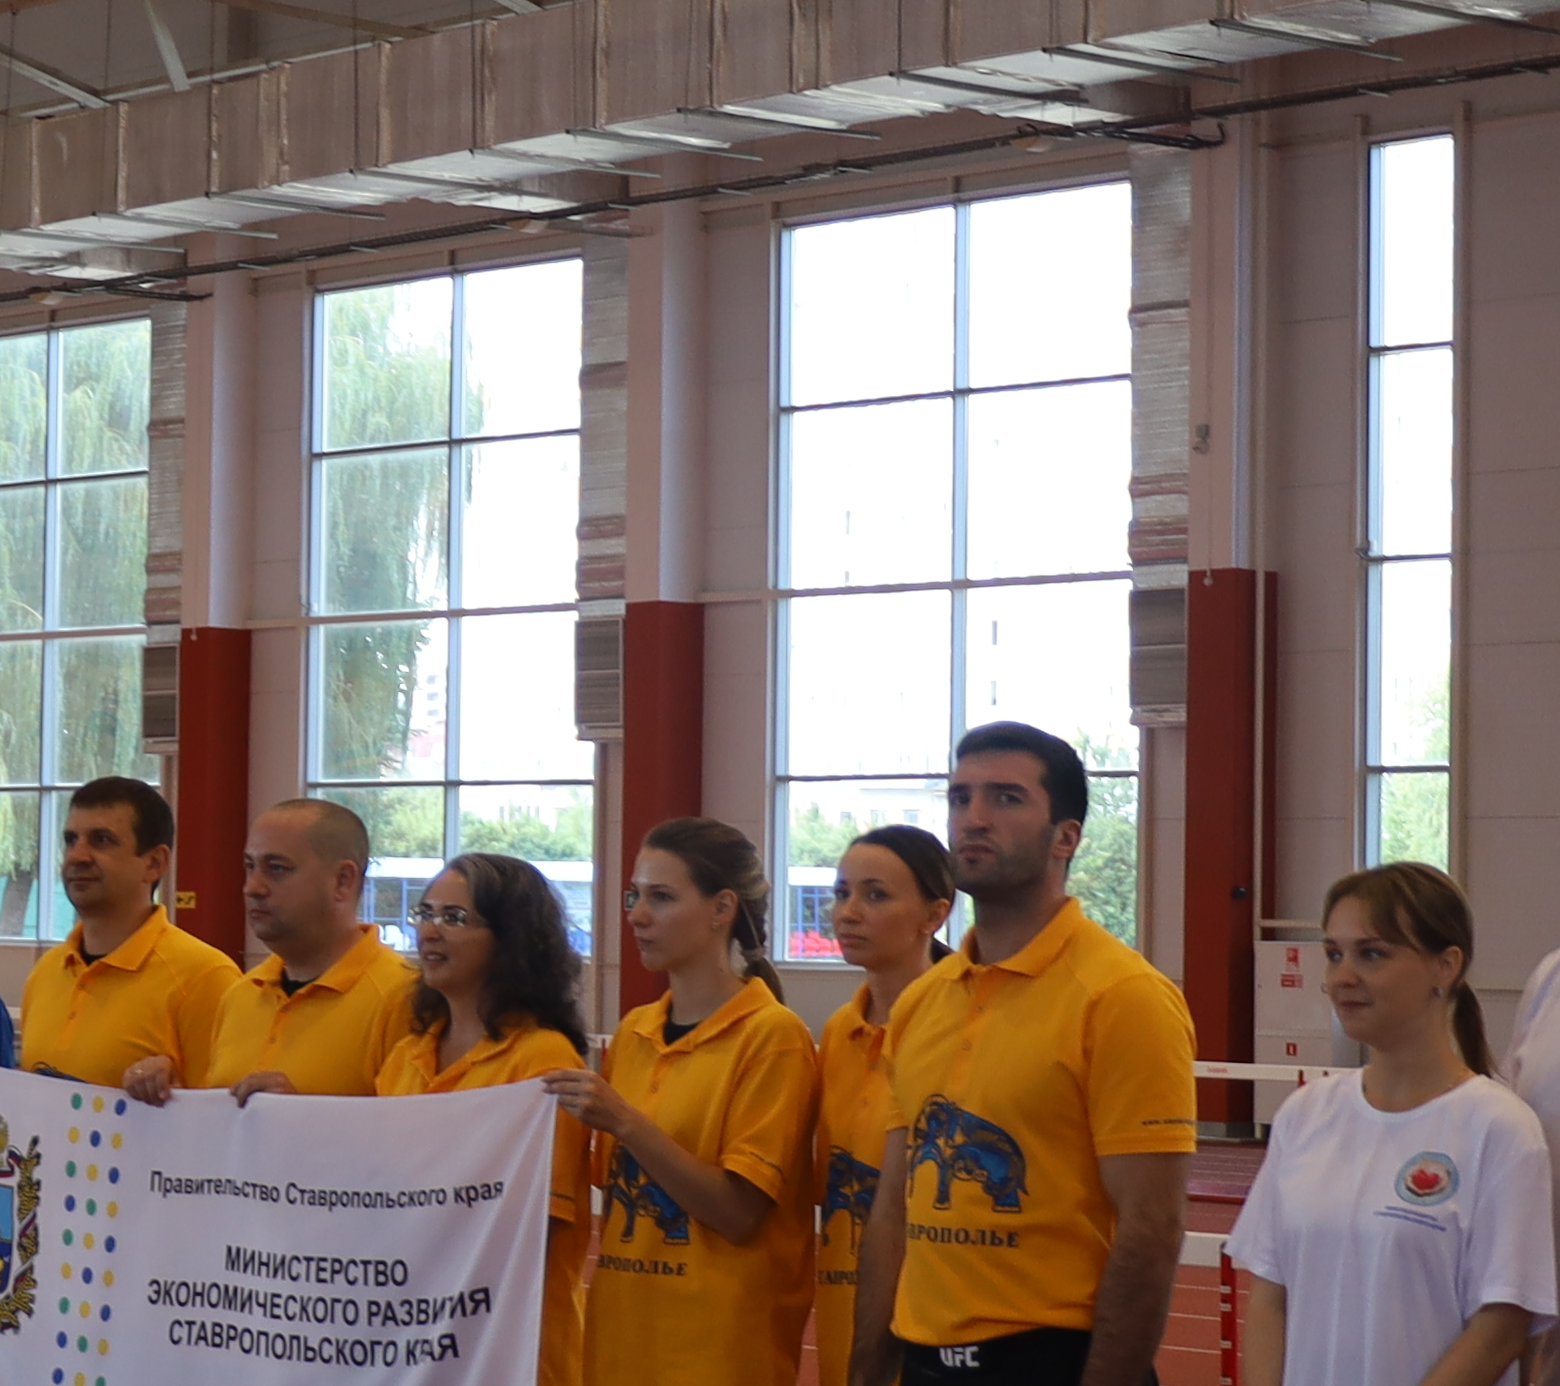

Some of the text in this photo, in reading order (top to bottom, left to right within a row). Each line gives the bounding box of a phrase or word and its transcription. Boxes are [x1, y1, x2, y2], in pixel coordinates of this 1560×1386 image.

[150, 1170, 504, 1212] Правительство Ставропольского края
[906, 1223, 1020, 1249] ВРОПОЛЬЕ
[224, 1244, 408, 1287] МИНИСТЕРСТВО
[147, 1278, 360, 1327] ЭКОНОМИЧЕСКОГО
[169, 1318, 399, 1368] СТАВРОПОЛЬСКОГО
[939, 1346, 980, 1368] UFC
